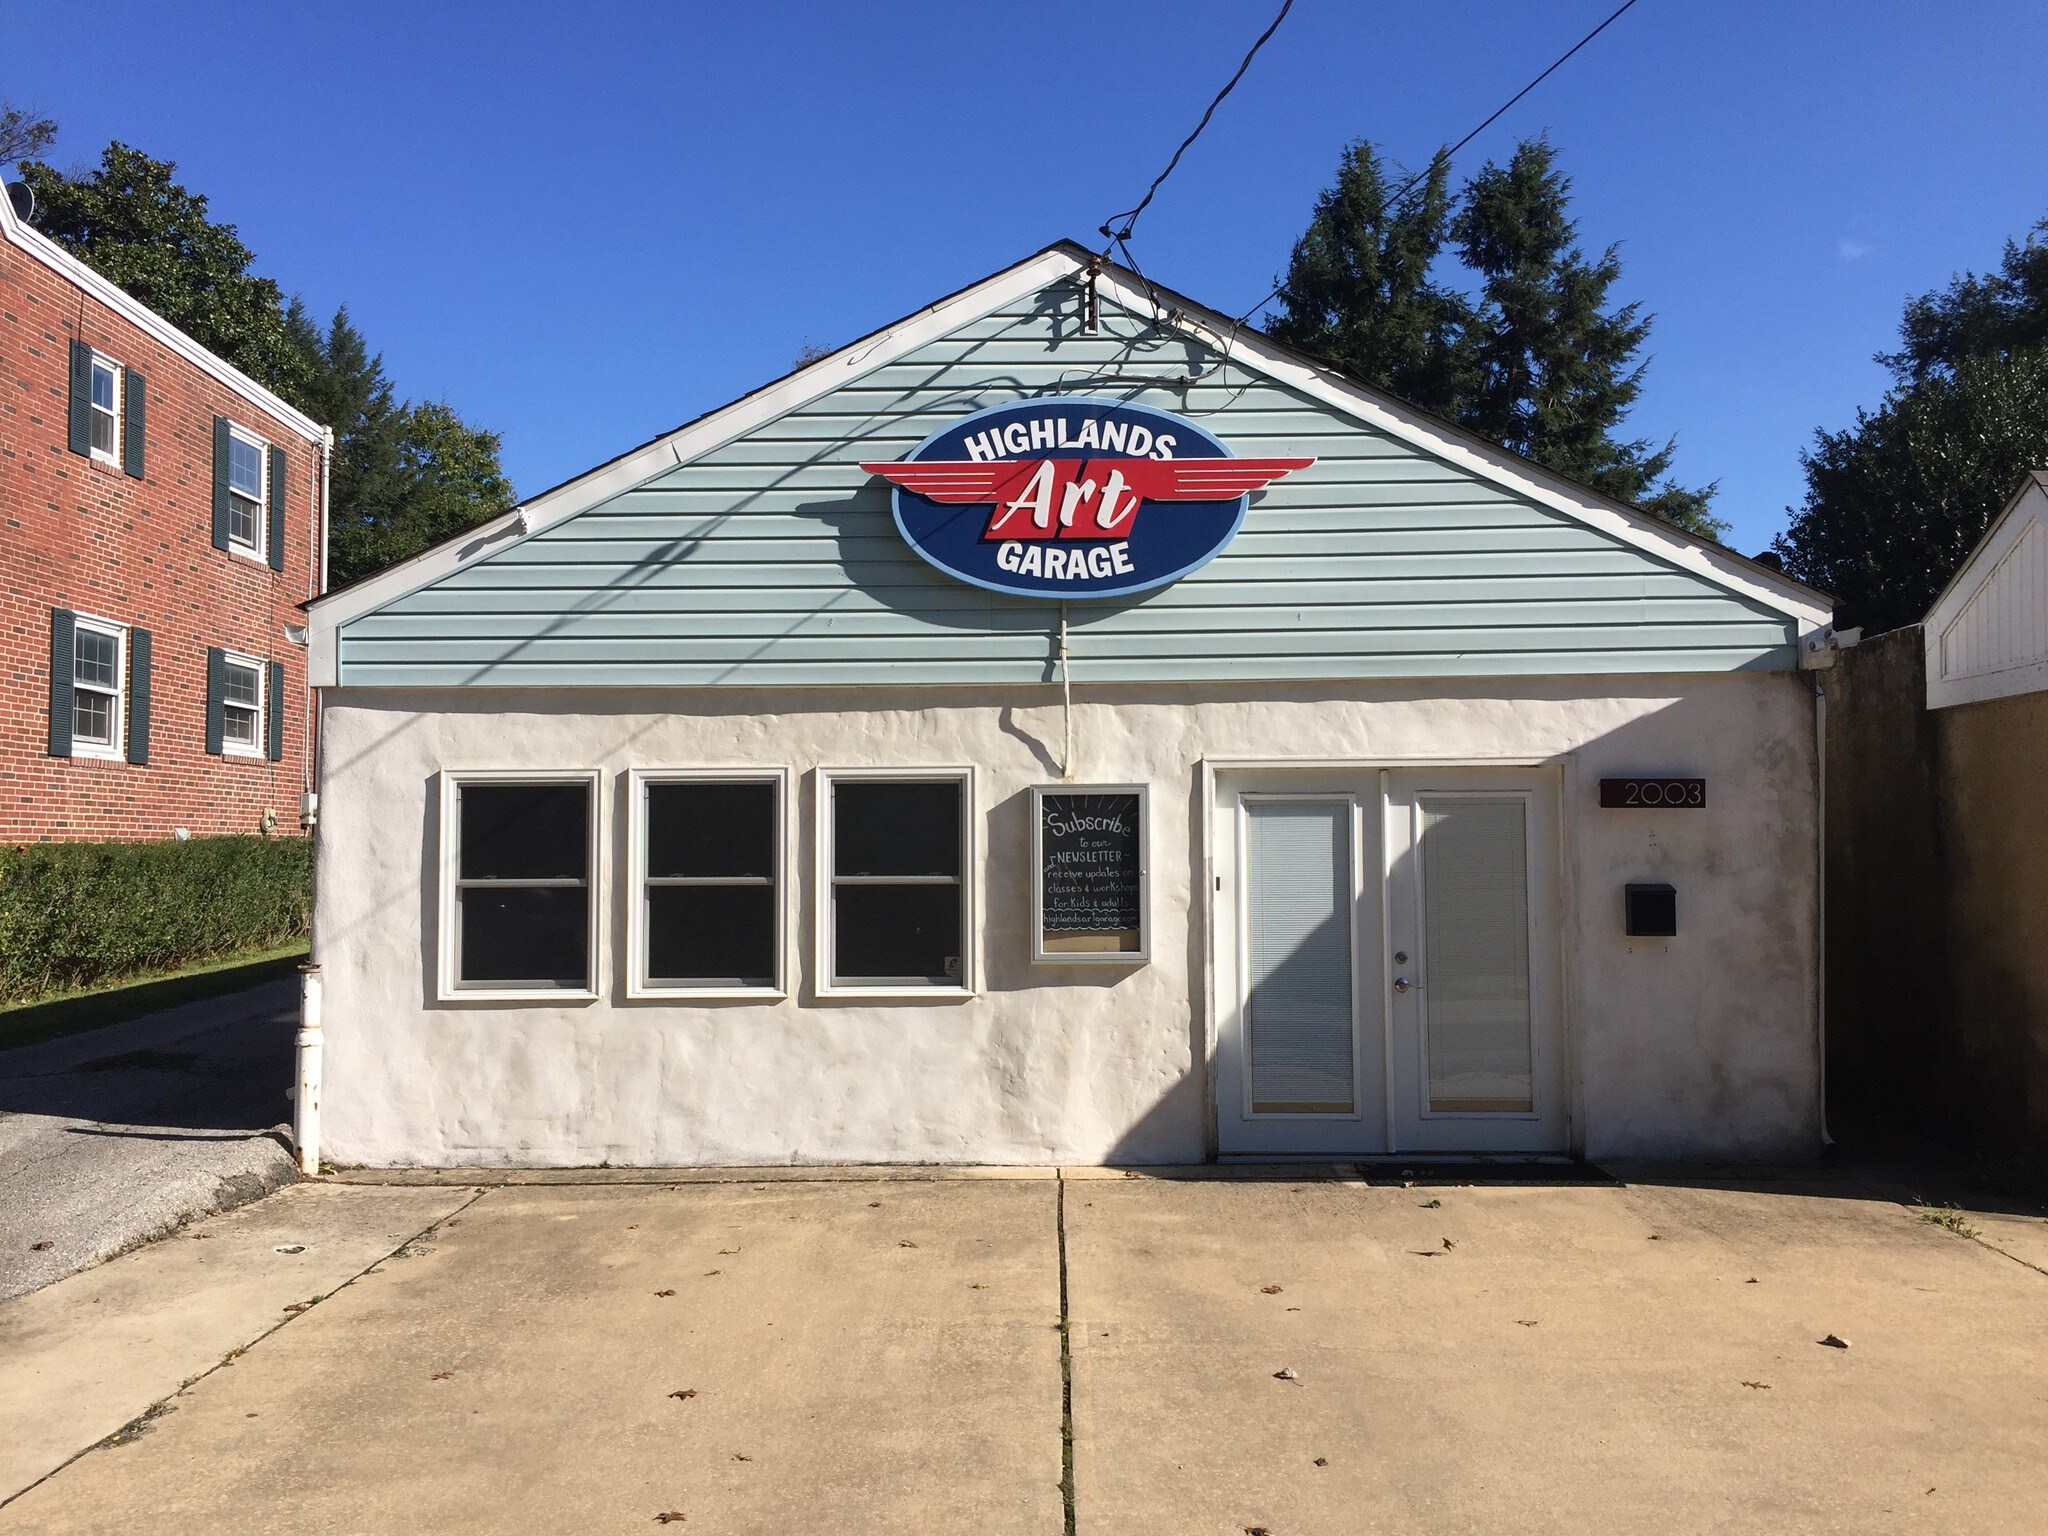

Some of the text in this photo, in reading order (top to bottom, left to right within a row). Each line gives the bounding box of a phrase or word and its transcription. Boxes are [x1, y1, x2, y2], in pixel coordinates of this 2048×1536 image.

[964, 418, 1177, 461] HIGHLANDS
[991, 459, 1137, 530] Art
[996, 540, 1135, 580] GARAGE
[1625, 782, 1701, 804] 2003
[1047, 812, 1131, 837] Subscribe
[1079, 837, 1112, 848] to our
[1057, 850, 1122, 863] NEWSLETTER
[1044, 859, 1056, 873] and
[1047, 870, 1083, 879] receive
[1085, 866, 1119, 883] updates
[1048, 882, 1083, 894] classes
[1053, 897, 1069, 908] for
[1043, 911, 1136, 927] highlandsartgaragecom
